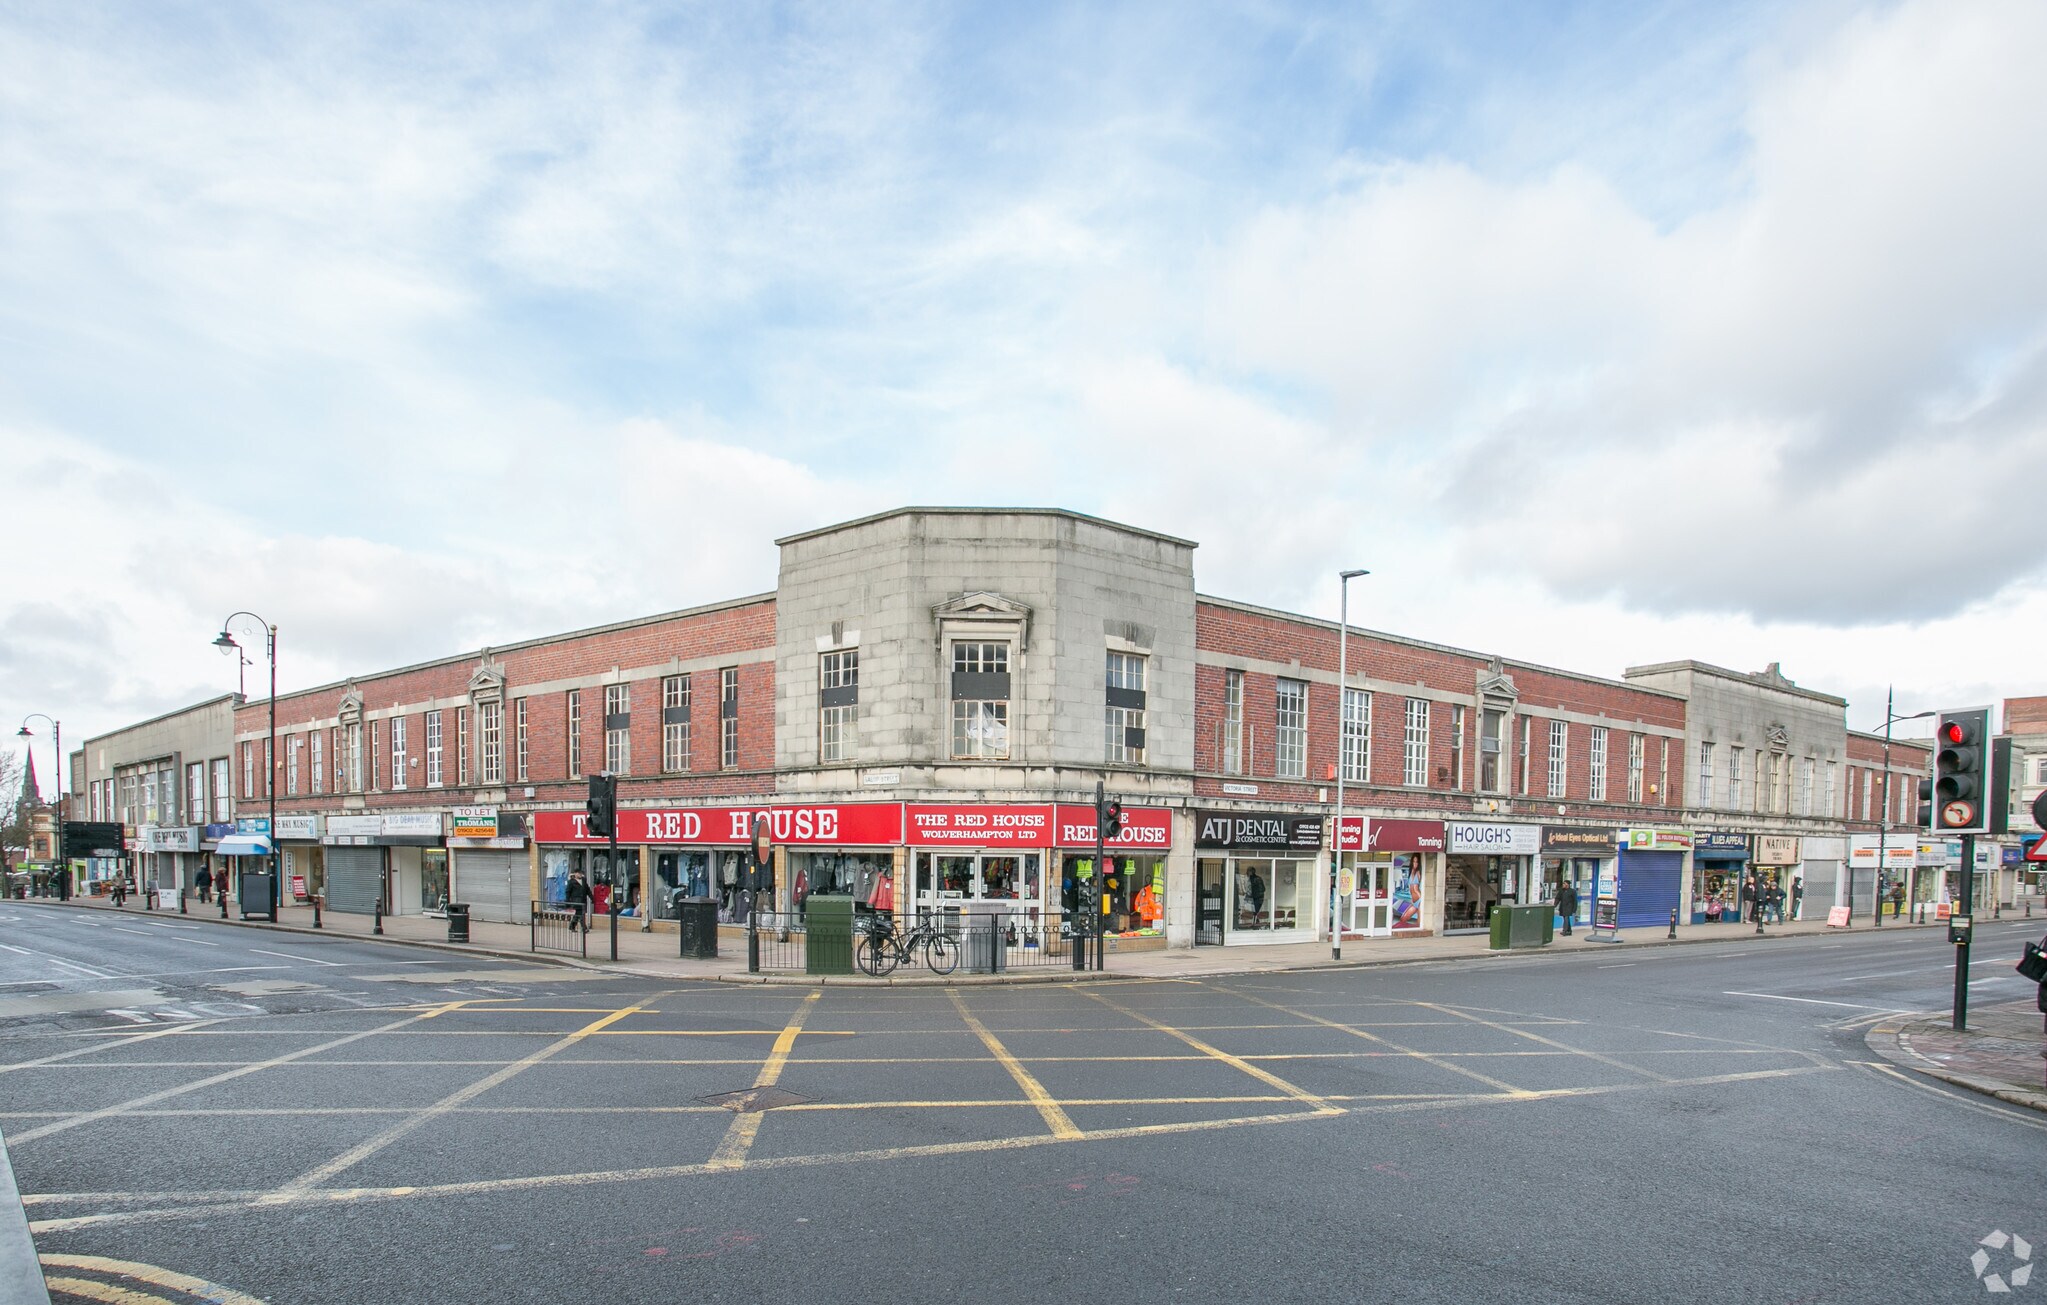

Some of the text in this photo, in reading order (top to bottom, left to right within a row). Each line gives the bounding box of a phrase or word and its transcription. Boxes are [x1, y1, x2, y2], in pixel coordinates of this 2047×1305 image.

[459, 808, 491, 816] TO LET
[456, 819, 494, 827] TROMANS
[645, 812, 702, 839] RED
[915, 814, 1045, 827] THE RED HOUSE
[921, 830, 1037, 839] WOLVERHAMPTON LTD
[1108, 826, 1166, 843] OUSE
[1201, 817, 1288, 845] ATJ DENTAL
[1455, 826, 1512, 843] HOUGH'S
[1235, 835, 1240, 843] &
[1267, 836, 1287, 844] CENTRE
[1341, 835, 1358, 844] tudio
[1418, 836, 1442, 848] Tanning
[1555, 832, 1609, 843] Ideal Eyes Optical Ltd
[1725, 835, 1744, 845] APPEAL
[1480, 843, 1504, 851] SALON
[1766, 839, 1791, 850] NATIVE
